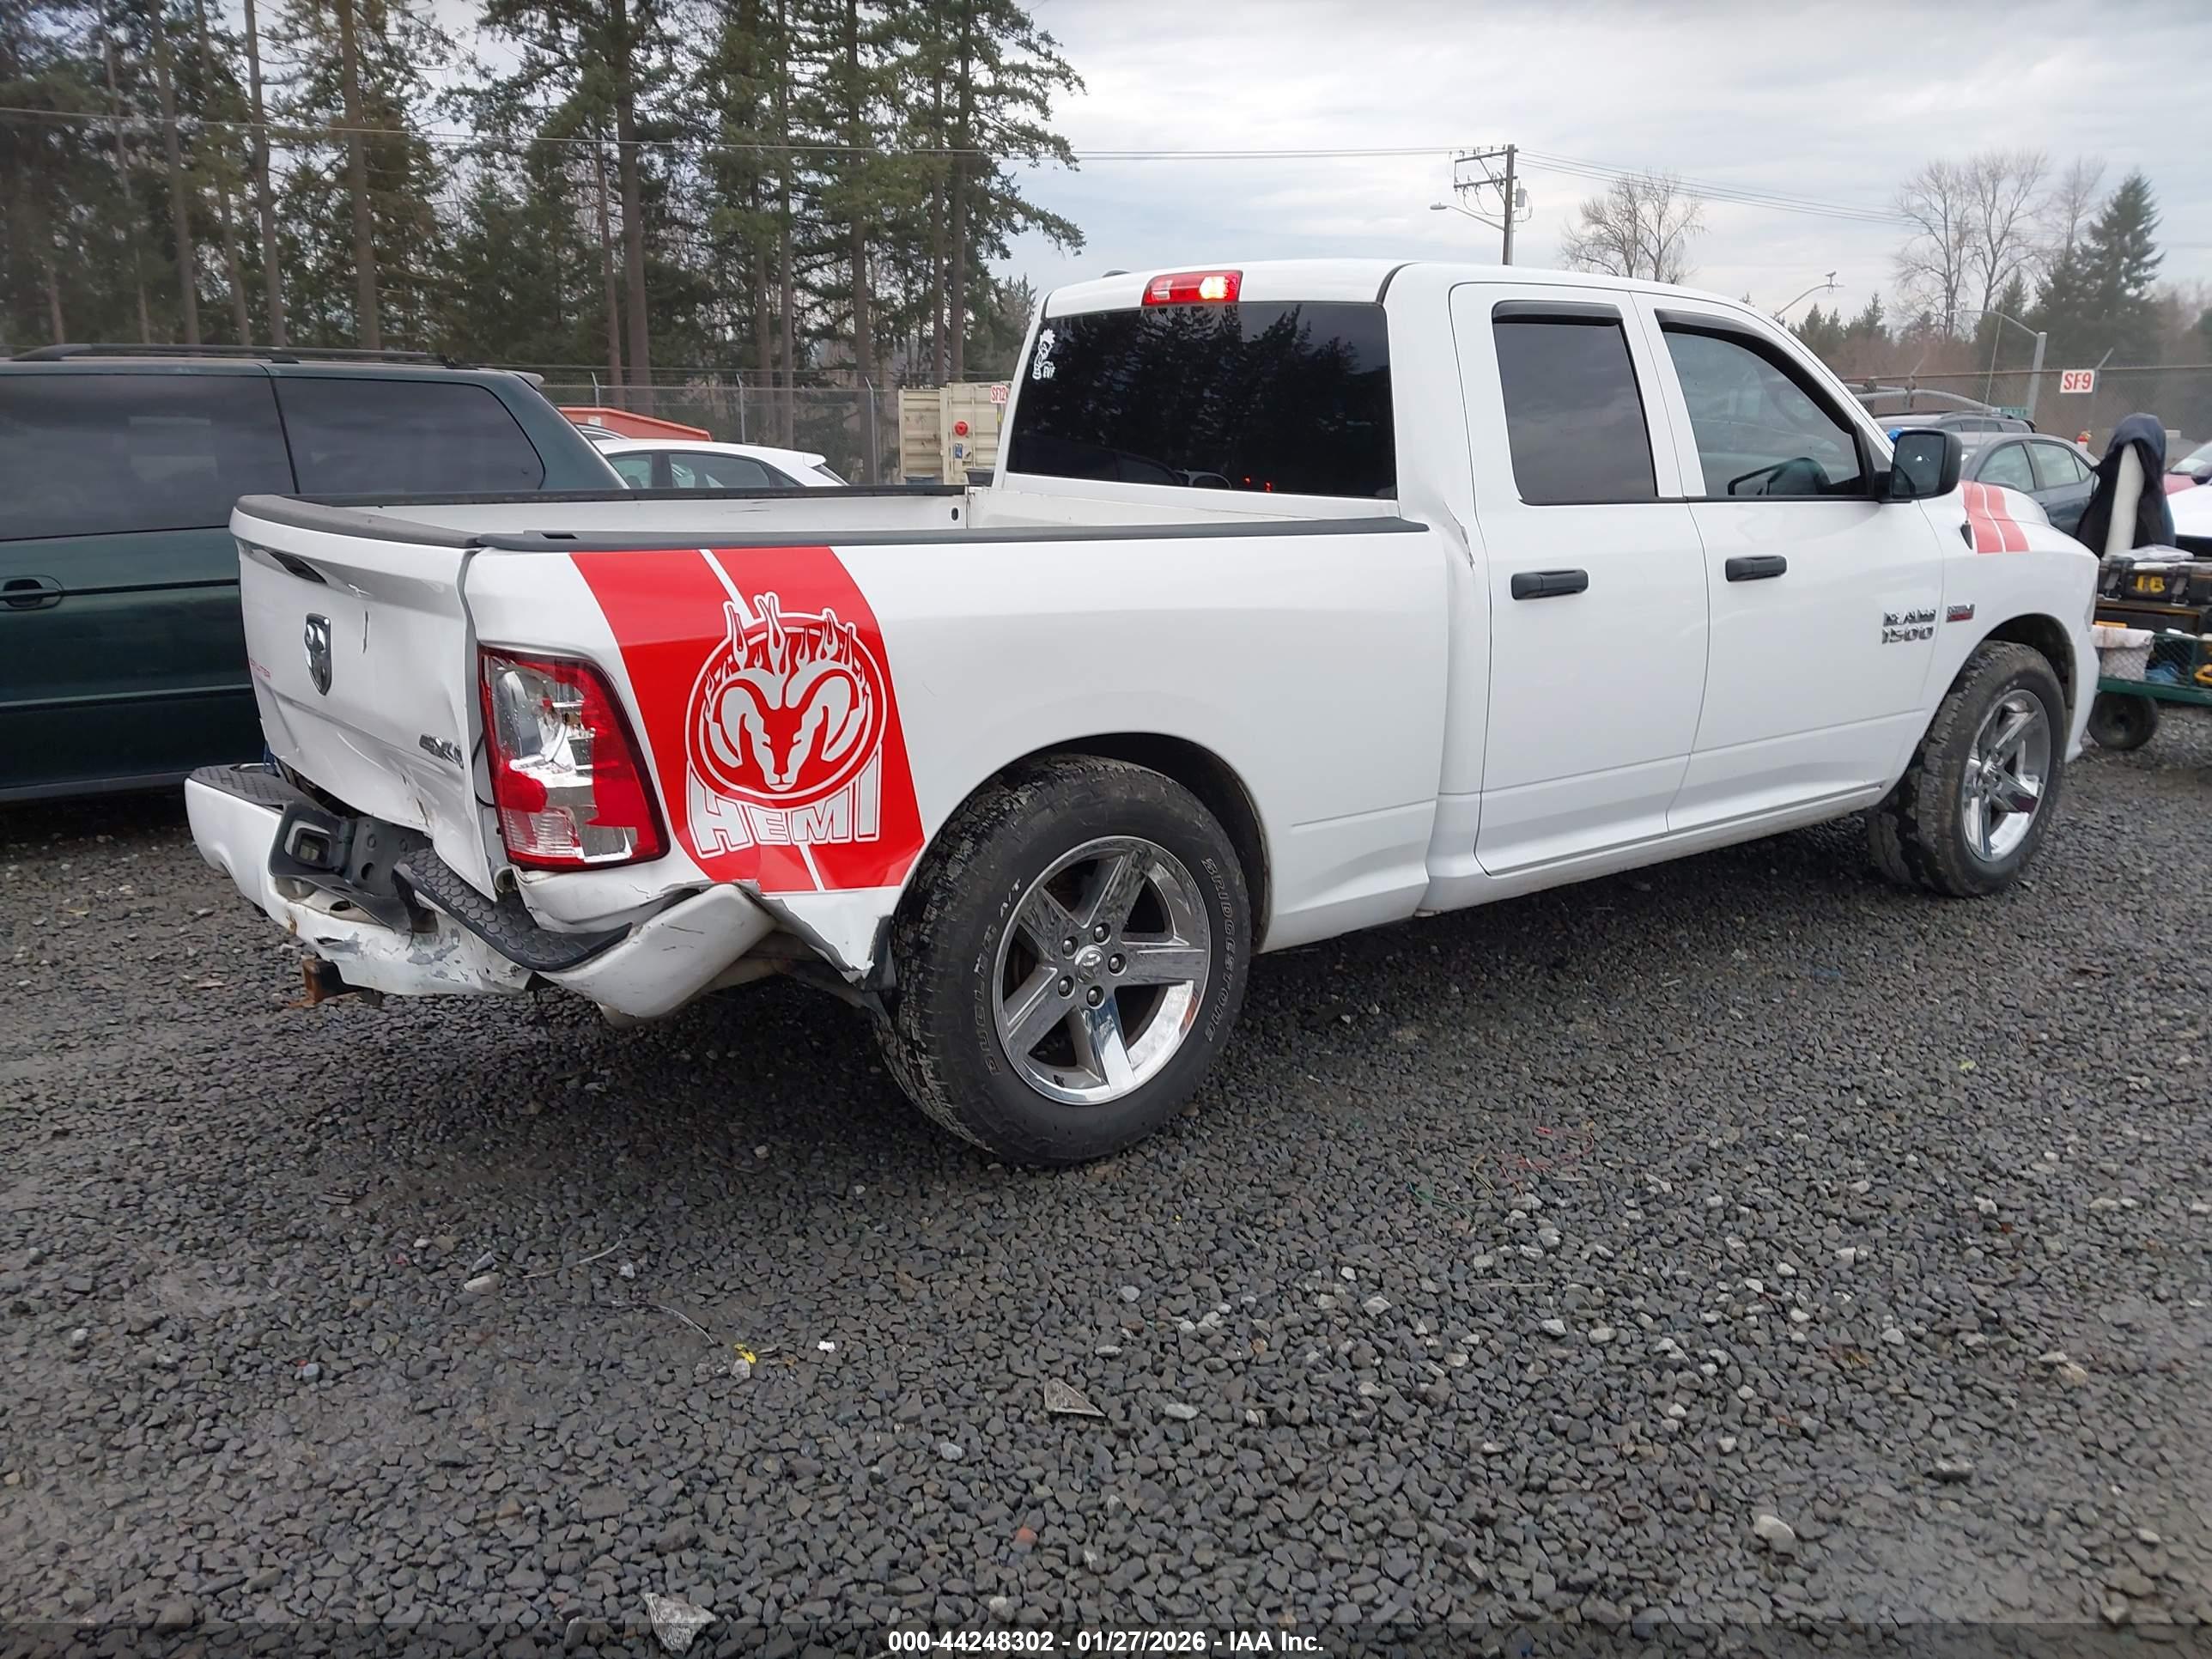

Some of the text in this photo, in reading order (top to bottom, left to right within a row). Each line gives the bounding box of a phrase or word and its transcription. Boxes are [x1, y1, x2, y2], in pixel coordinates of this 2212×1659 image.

[2063, 372, 2092, 390] SF9
[1883, 609, 1936, 627] RAM
[1881, 625, 1934, 645] 1500
[686, 749, 880, 858] HEMI
[1201, 858, 1237, 1042] BRIDGESTONE
